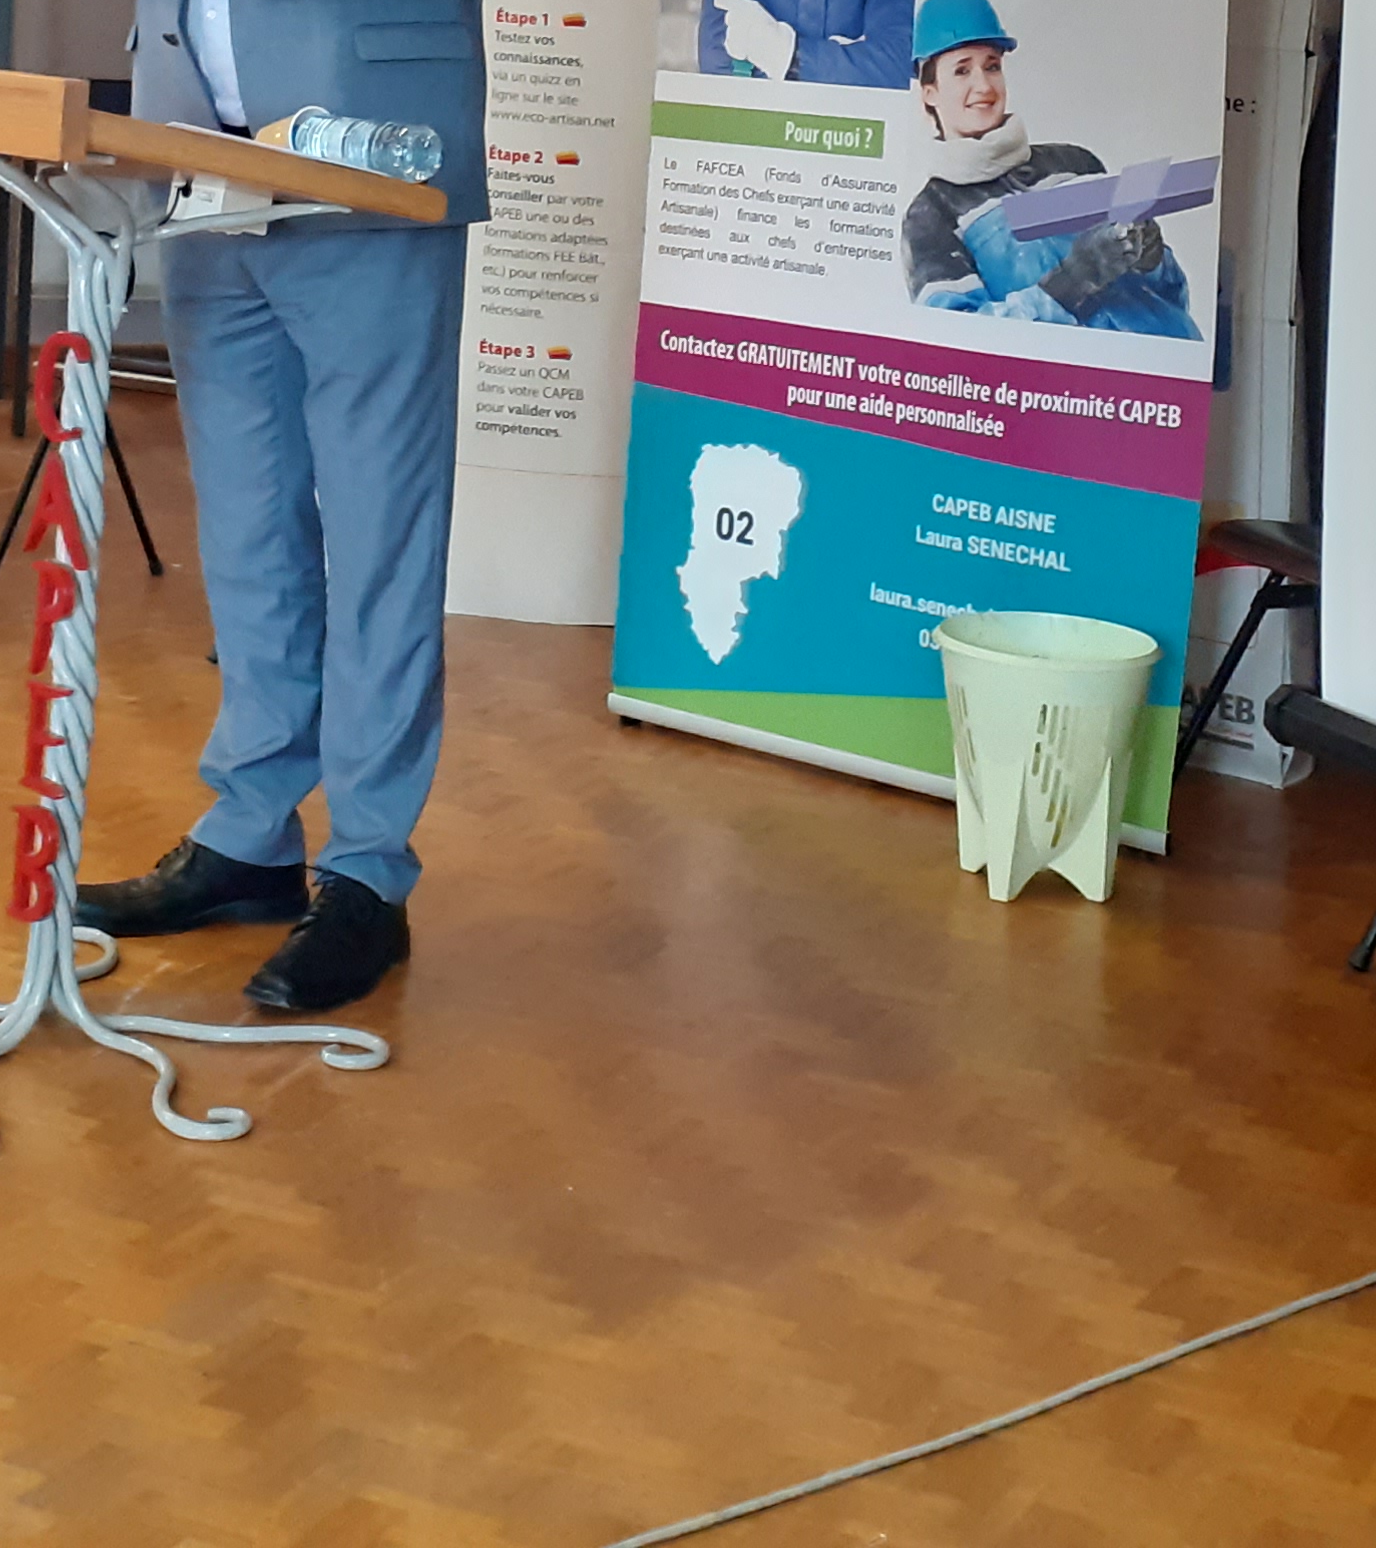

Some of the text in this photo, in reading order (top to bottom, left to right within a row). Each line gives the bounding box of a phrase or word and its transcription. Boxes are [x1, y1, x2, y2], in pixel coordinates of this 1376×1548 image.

[496, 7, 538, 27] Étape
[495, 29, 556, 46] Testez vos
[493, 51, 584, 69] connaissances,
[490, 110, 616, 128] www.eco-artisan.net
[785, 121, 862, 150] Pour quoi
[488, 145, 544, 165] Étape 2
[487, 167, 555, 184] Faites-vous
[696, 160, 745, 177] FAFCEA
[765, 166, 801, 185] (Fonds
[570, 195, 604, 207] votre
[662, 178, 896, 217] Formation des Chefs exerçant une activité
[660, 199, 895, 239] Artisanale) finance les formations
[550, 231, 608, 247] adaptées
[659, 221, 711, 239] destinées
[767, 234, 797, 251] chefs
[658, 243, 829, 277] exerçant une activité artisanale.
[541, 269, 599, 284] renforcer
[503, 287, 586, 303] compétences
[479, 338, 535, 360] Étape 3
[477, 361, 570, 381] Passez QCM
[660, 329, 1182, 428] Contactez GRATUITEMENT votre conseillère de proximité CAPEB
[542, 386, 584, 401] CAPEB
[507, 403, 577, 420] valider vos
[787, 385, 1005, 438] pour une aide personnalisée
[931, 493, 1057, 534] CAPEB AISNE
[714, 507, 754, 545] 02
[915, 524, 1072, 572] Laura SENECHAL
[6, 331, 91, 922] CAPEB
